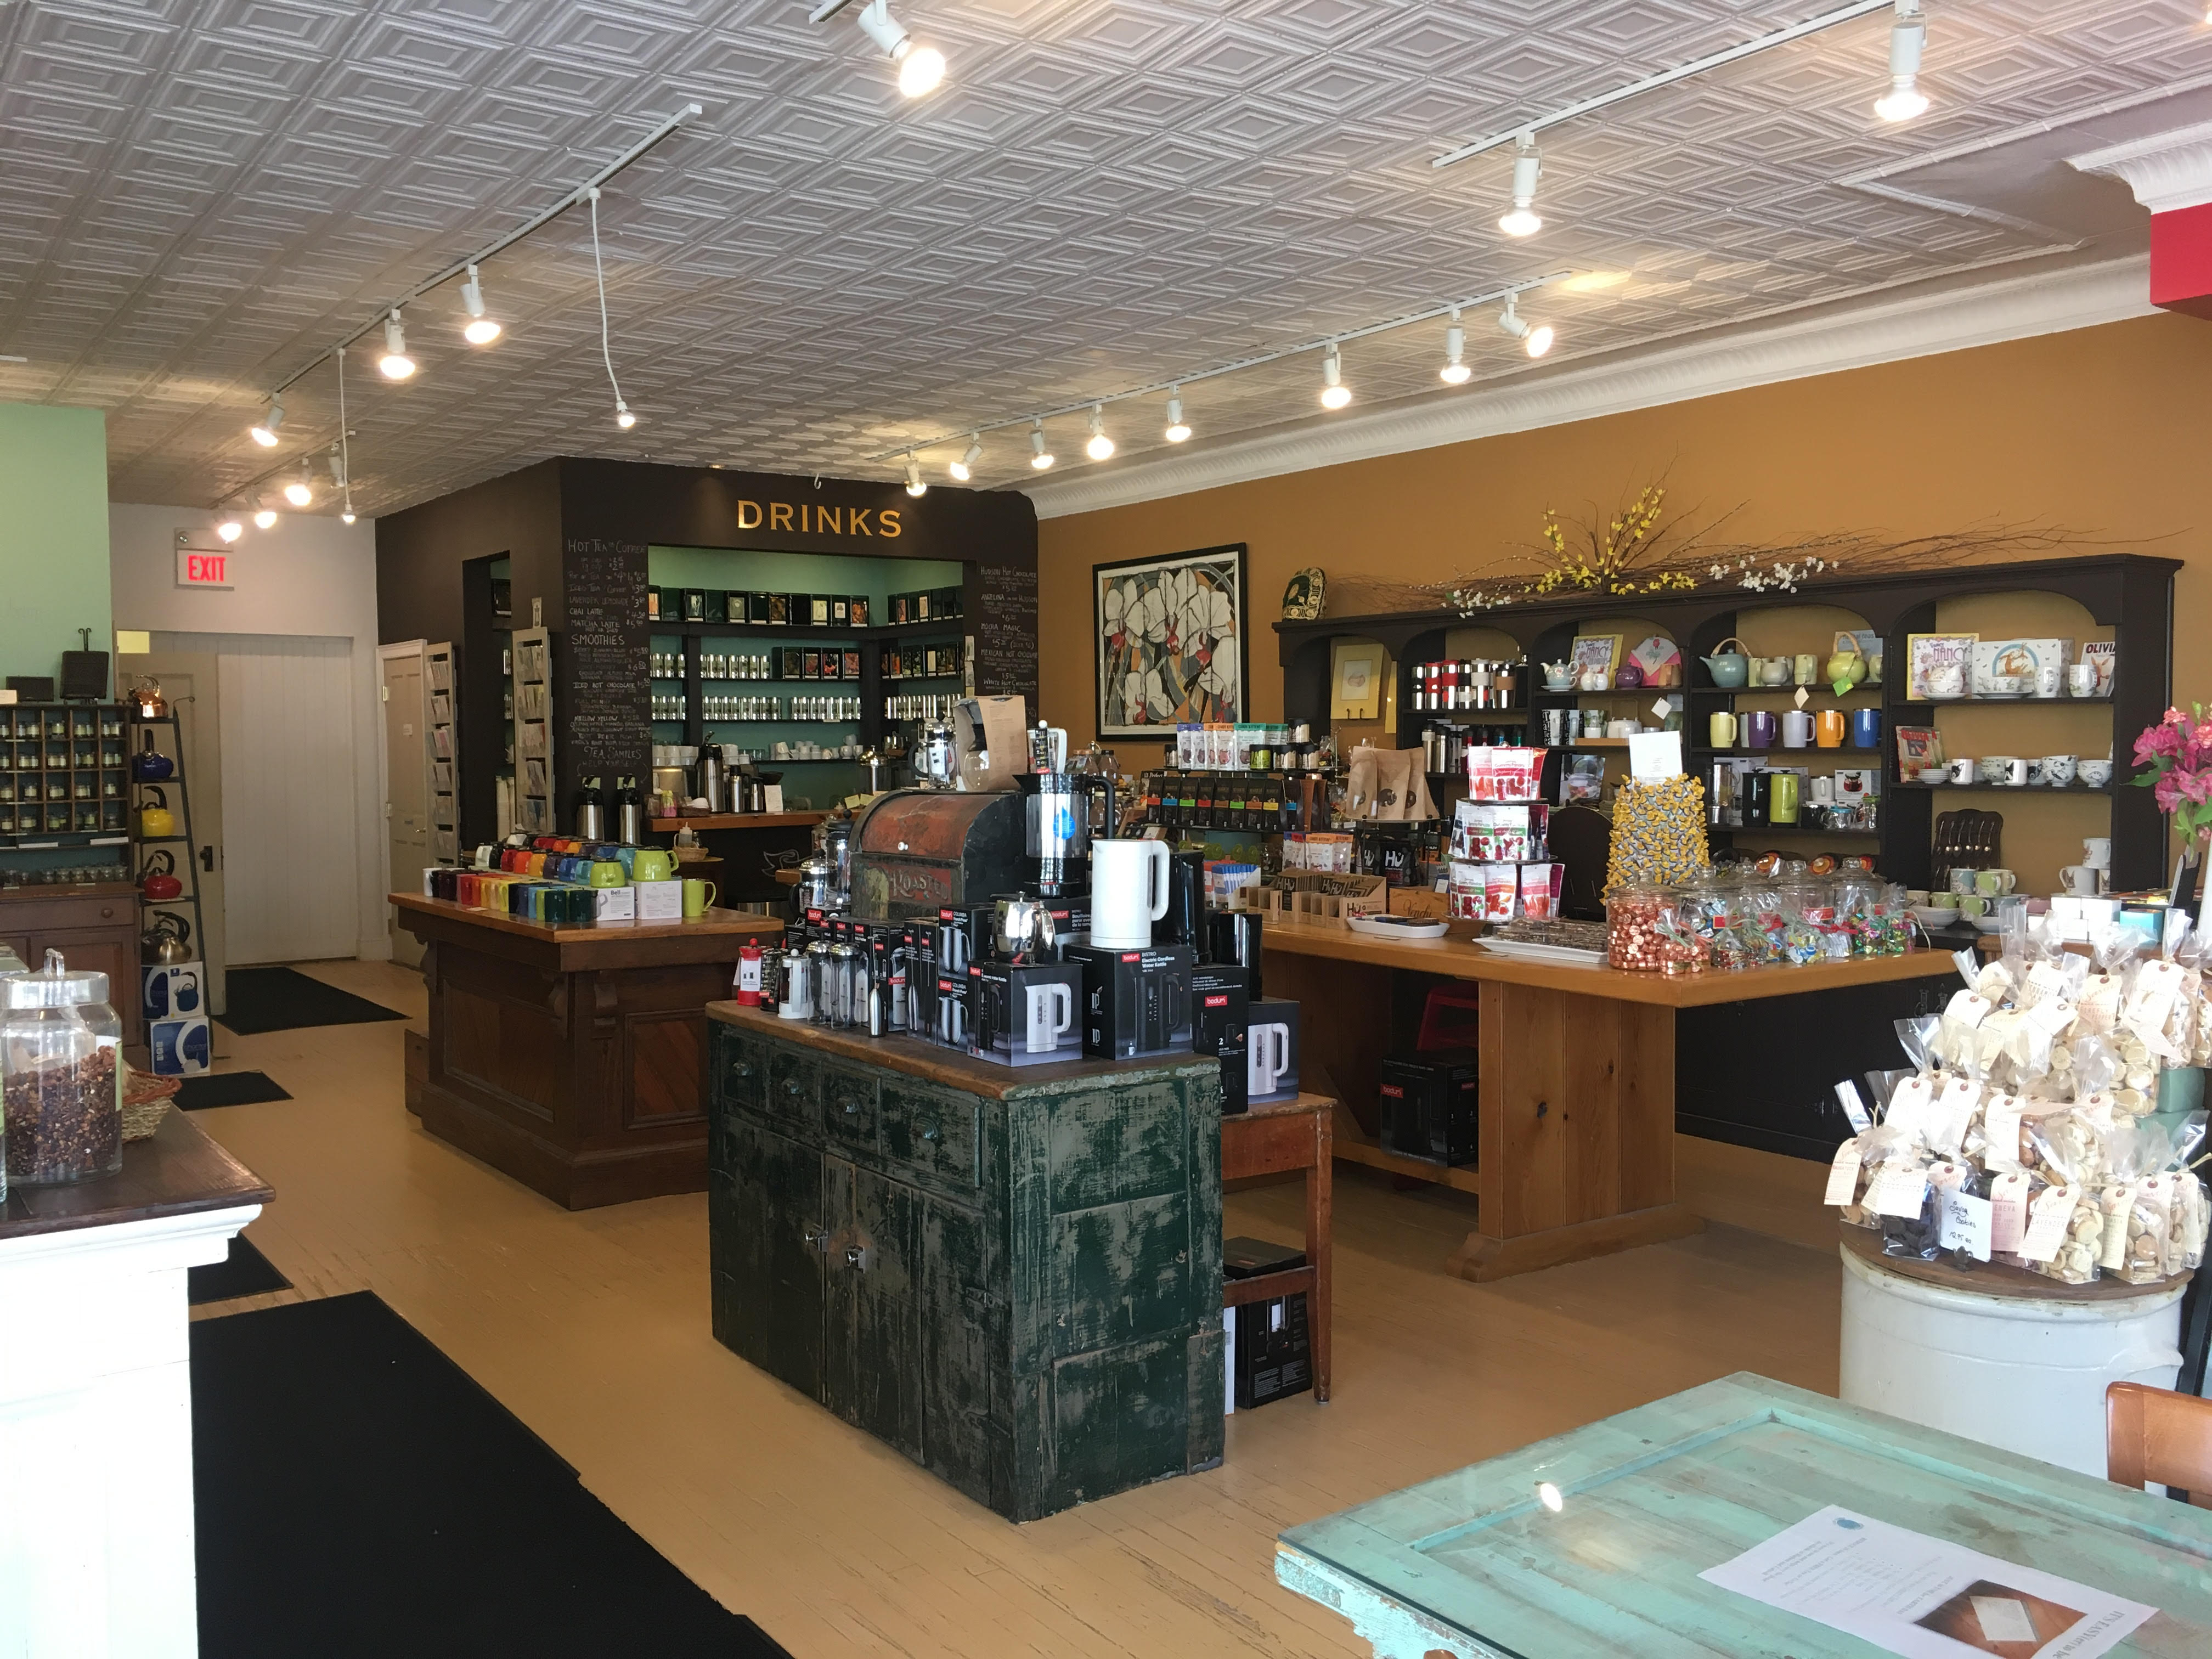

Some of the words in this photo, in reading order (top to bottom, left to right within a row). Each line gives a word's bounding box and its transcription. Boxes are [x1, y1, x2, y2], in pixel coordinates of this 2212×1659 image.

[737, 500, 901, 538] DRINKS
[568, 539, 589, 552] HOT
[591, 539, 608, 552] TEA
[616, 540, 646, 554] COFFEE
[188, 555, 226, 582] EXIT
[981, 566, 1001, 575] HUDSON
[1012, 566, 1036, 578] CHOCOLATE
[1003, 624, 1021, 633] MAGIC
[571, 634, 625, 645] SMOOTHIES
[981, 649, 1003, 657] MEXICAN
[1586, 646, 1609, 658] NANCY
[1934, 647, 1968, 662] NANCY
[984, 678, 1000, 686] WHITE
[584, 746, 605, 759] TEA
[608, 747, 641, 759] SAMPLES
[889, 868, 949, 900] ROASTED
[1404, 899, 1432, 917] Venchi
[1383, 1086, 1401, 1095] bodum
[1956, 1216, 1976, 1228] Cookies
[2032, 1218, 2066, 1228] LAVENDER
[2102, 1611, 2125, 1623] IT'S
[2062, 1641, 2075, 1652] to
